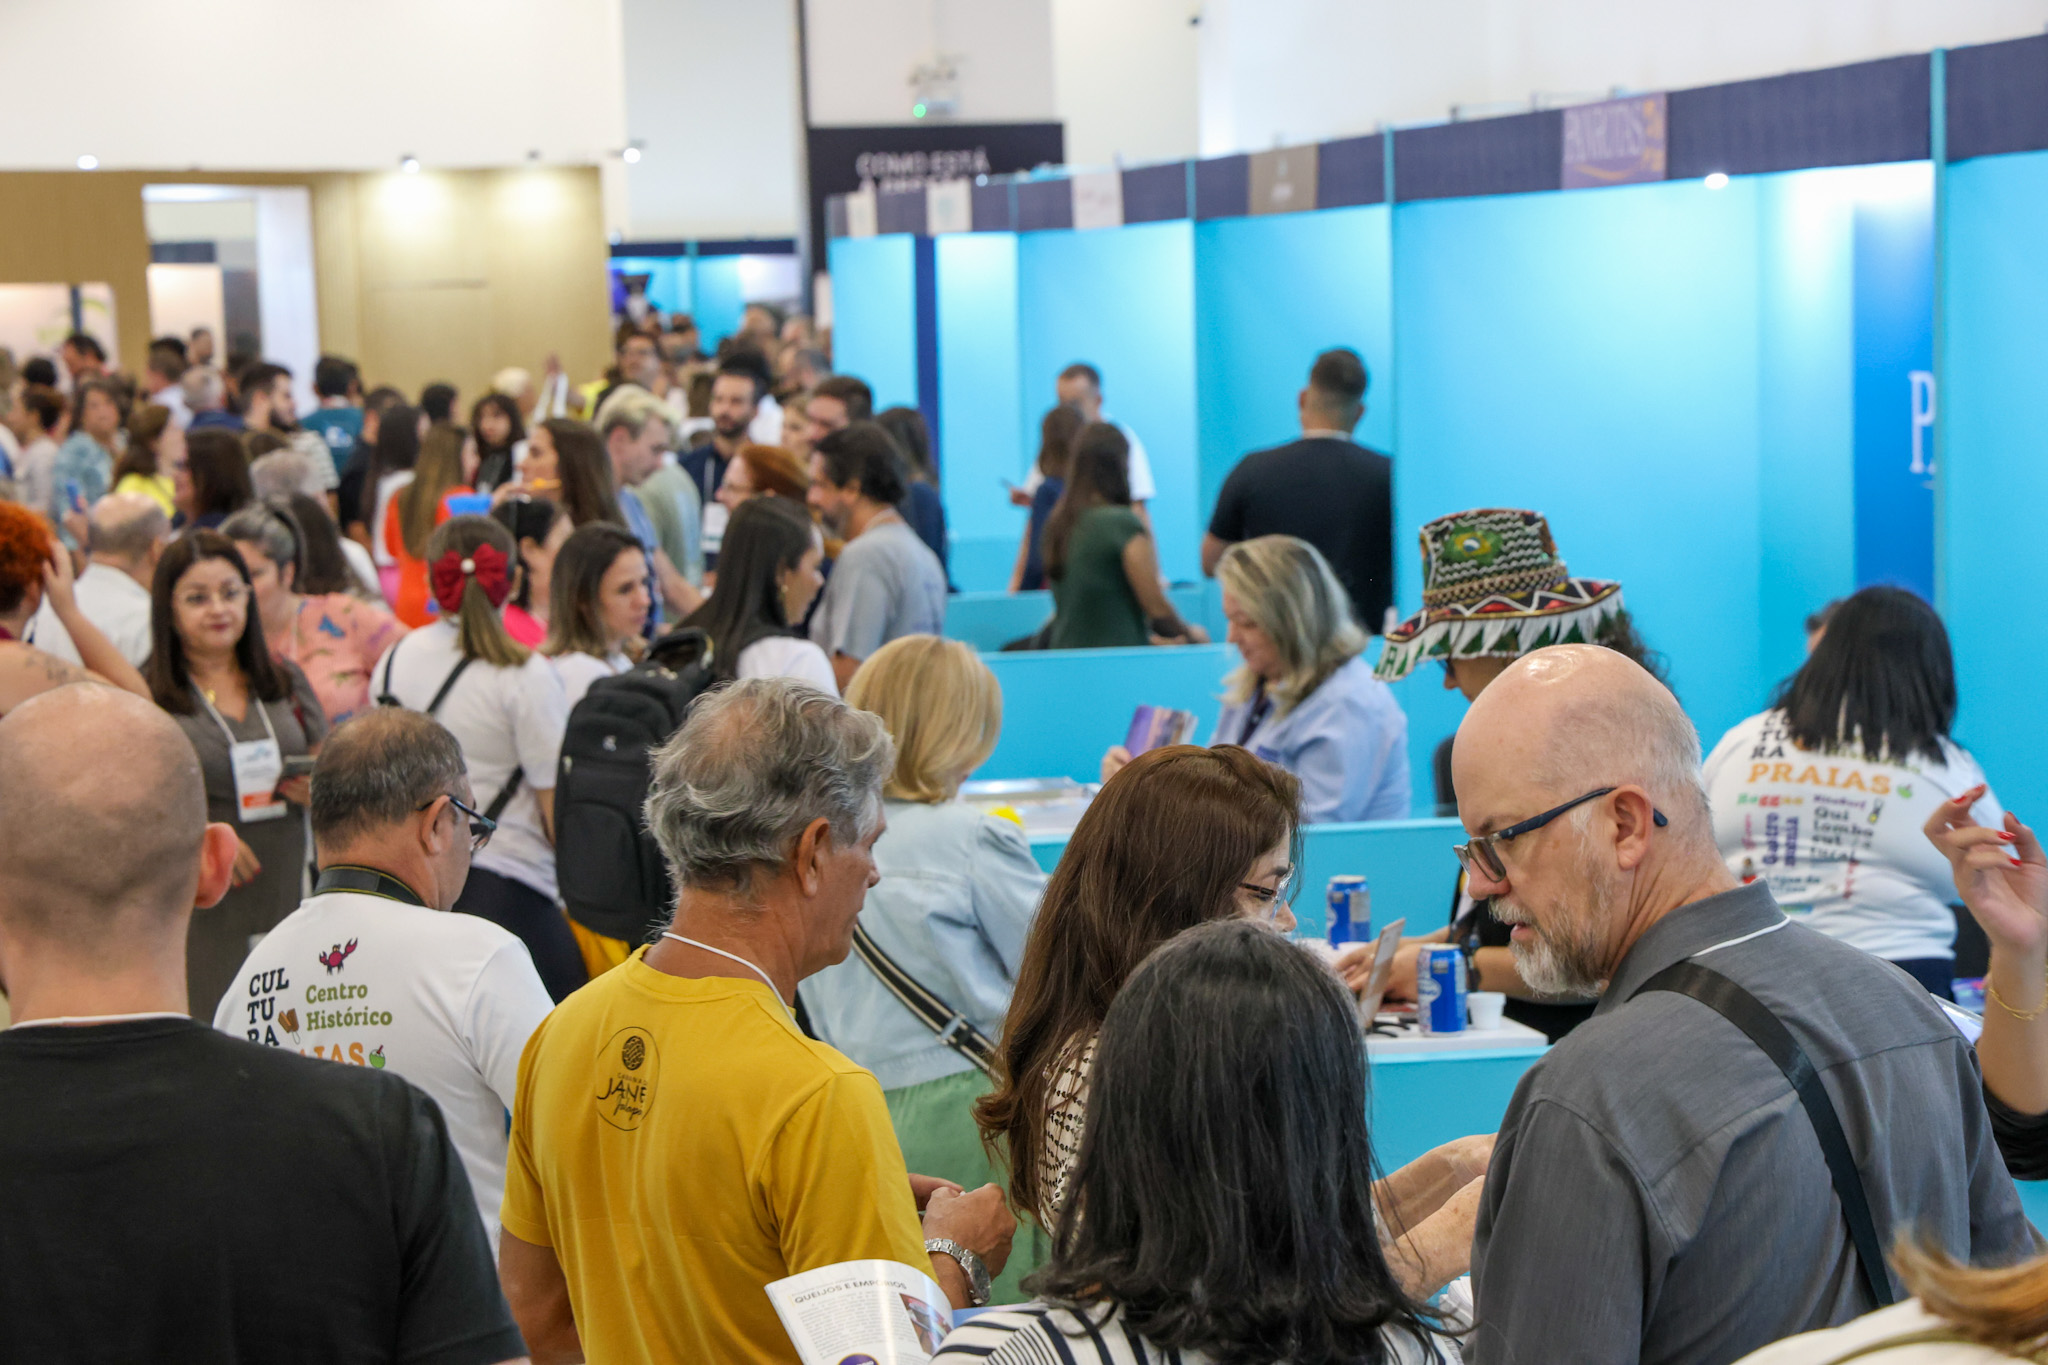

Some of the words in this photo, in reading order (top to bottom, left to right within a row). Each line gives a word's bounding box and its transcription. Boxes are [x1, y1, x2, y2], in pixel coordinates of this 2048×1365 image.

[1751, 746, 1785, 760] RA
[1747, 762, 1892, 795] PRAIAS
[249, 967, 289, 997] CUL
[306, 982, 368, 1004] Centro
[247, 996, 275, 1024] TU
[306, 1006, 393, 1031] Histórico
[596, 1077, 648, 1103] JANE
[794, 1284, 843, 1304] QUEIJOS
[844, 1282, 853, 1290] E
